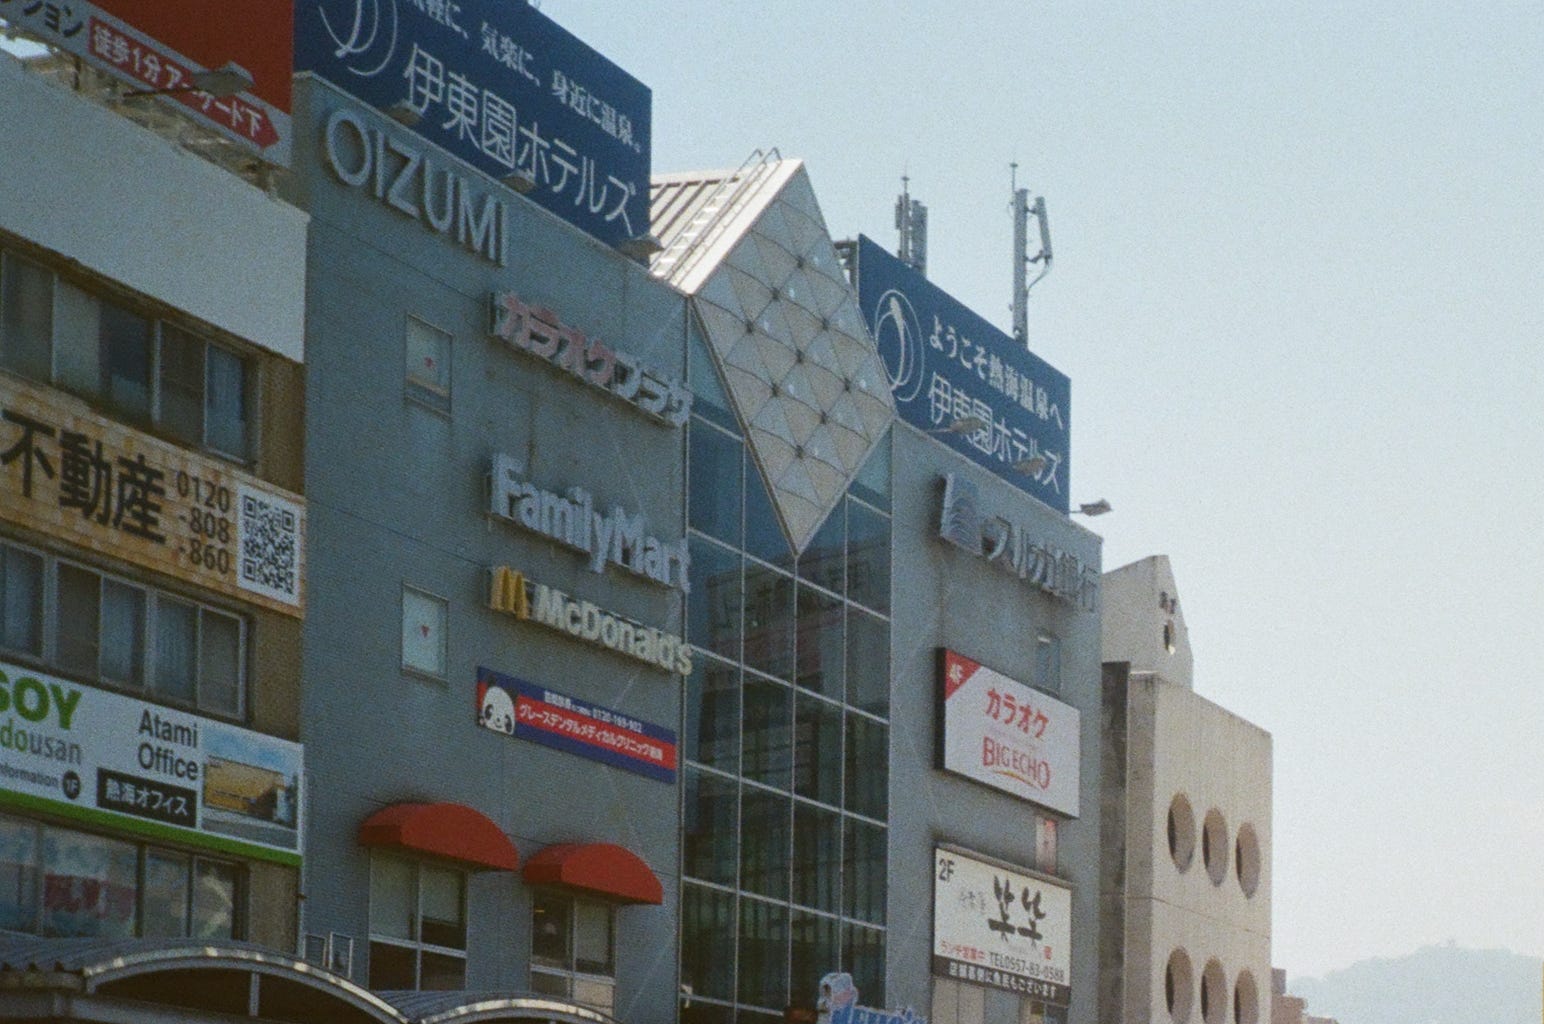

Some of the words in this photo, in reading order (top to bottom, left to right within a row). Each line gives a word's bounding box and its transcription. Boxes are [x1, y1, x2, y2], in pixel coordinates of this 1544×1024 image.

[403, 43, 637, 236] 伊東園ホテルズ
[0, 408, 166, 544] 不動産
[177, 470, 230, 513] 0120
[491, 453, 691, 593] FamilyMart
[138, 709, 199, 749] Atami
[985, 688, 1050, 739] カラオケ
[137, 743, 199, 781] Office
[104, 777, 189, 817] 熱海オフィス
